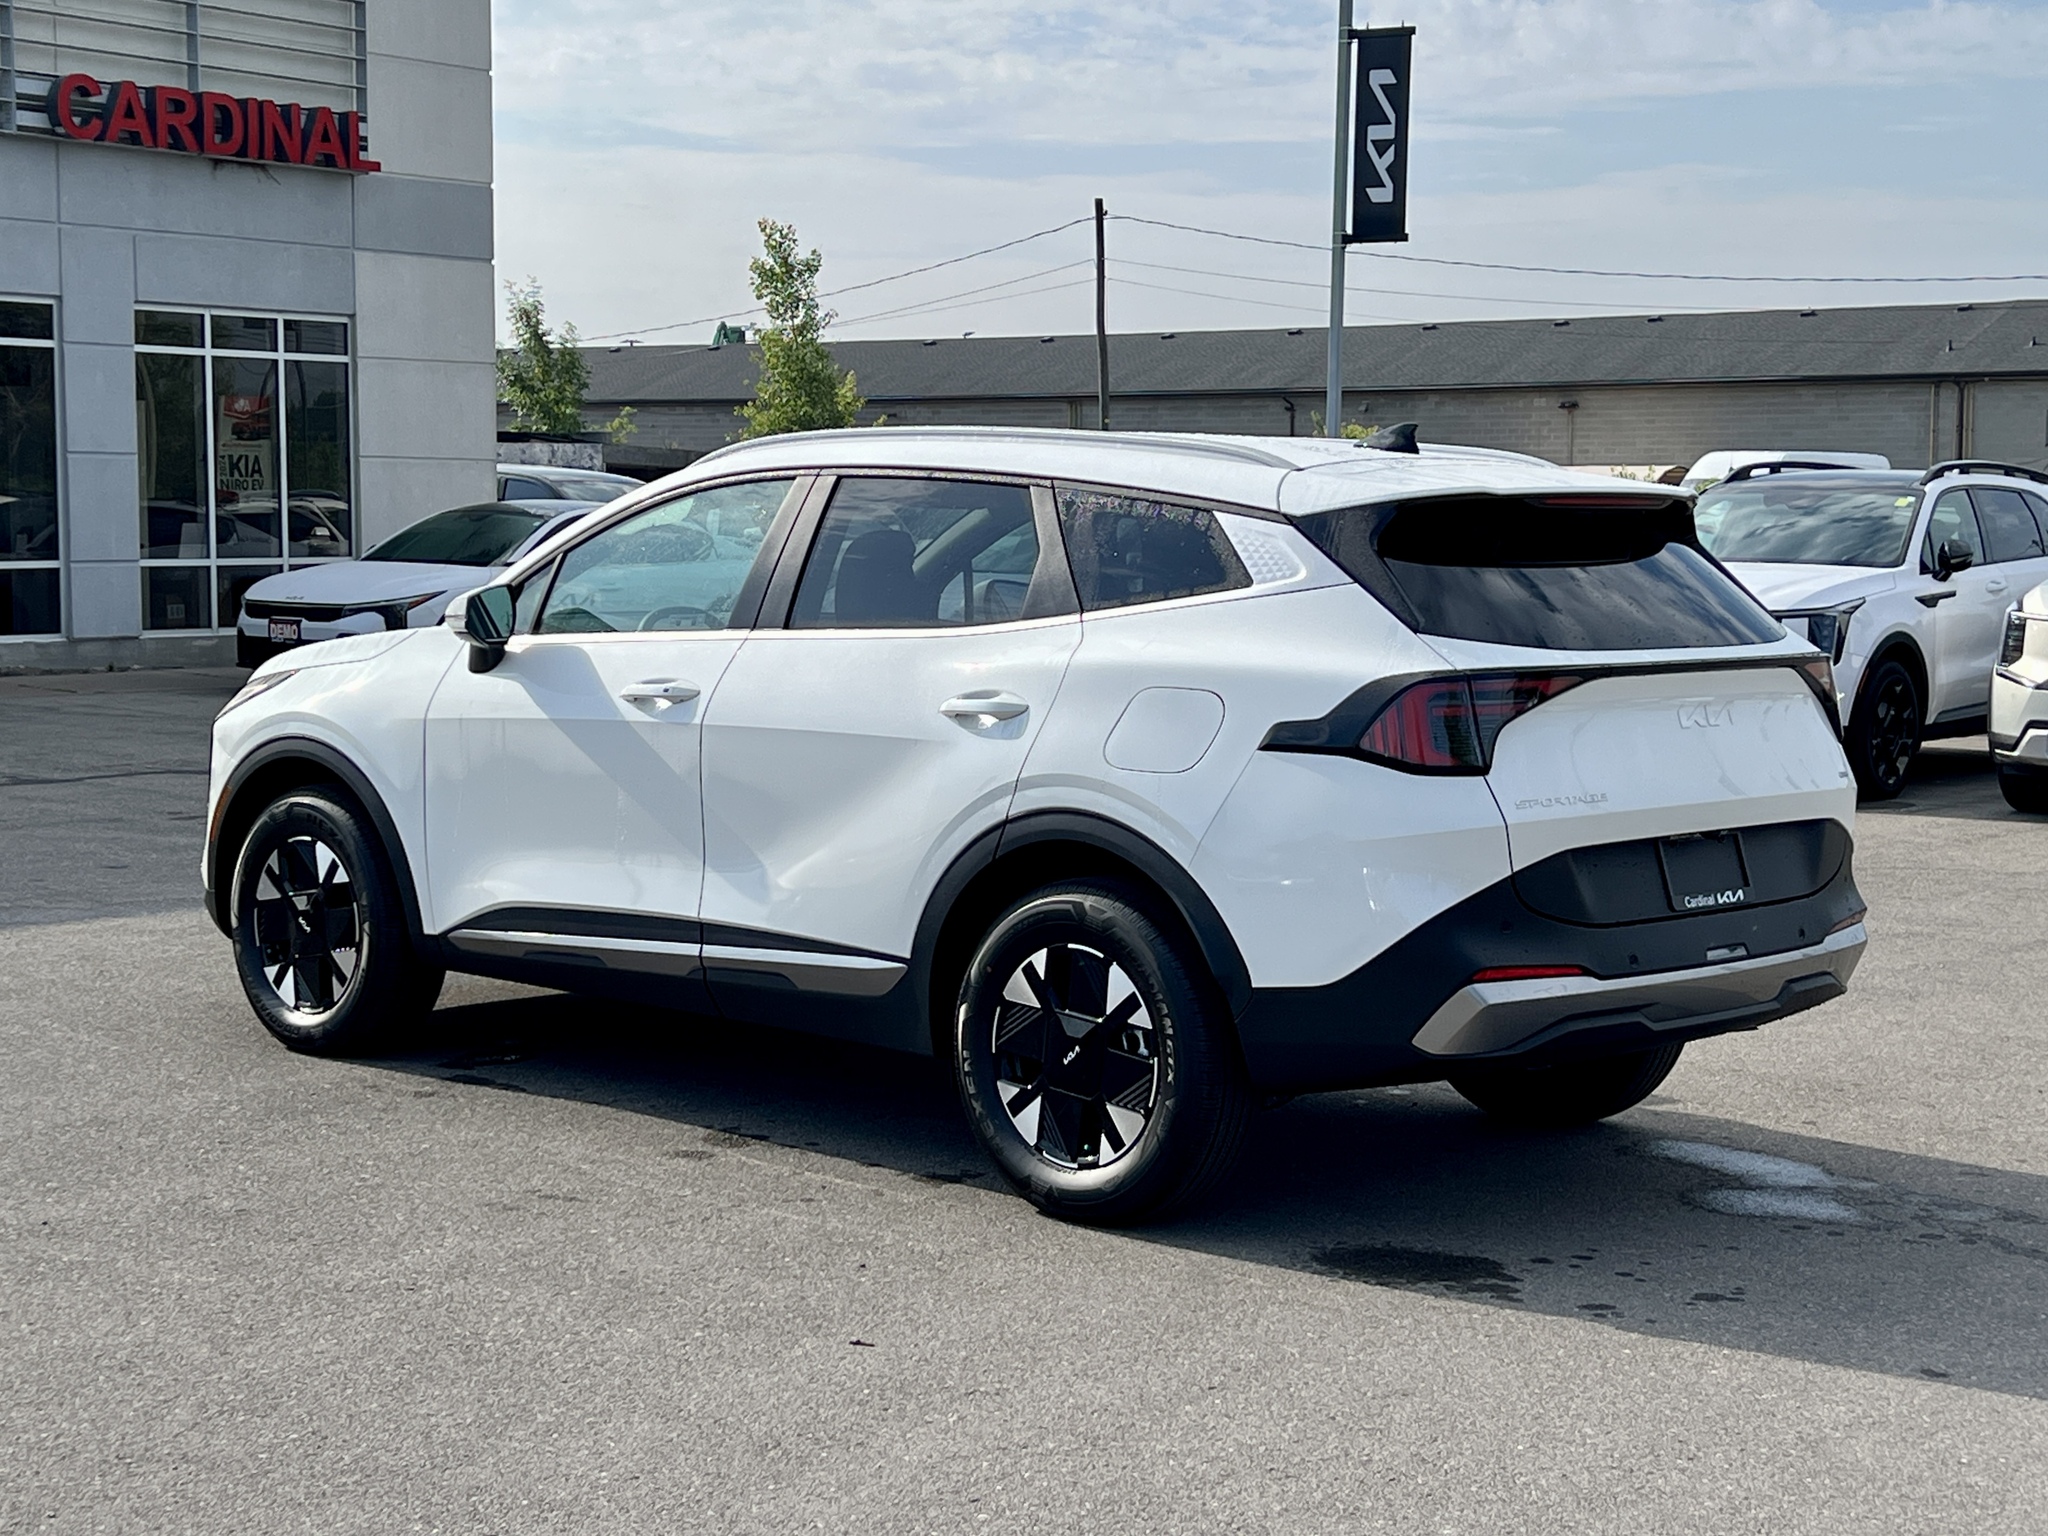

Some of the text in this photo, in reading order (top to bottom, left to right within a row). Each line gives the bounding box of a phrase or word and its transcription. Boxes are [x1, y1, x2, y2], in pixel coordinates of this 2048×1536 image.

[55, 73, 381, 172] CARDINAL
[227, 454, 264, 478] KIA
[220, 479, 264, 491] NIRO EV
[270, 623, 298, 640] DEMO
[1684, 889, 1744, 909] Cardinal KIA
